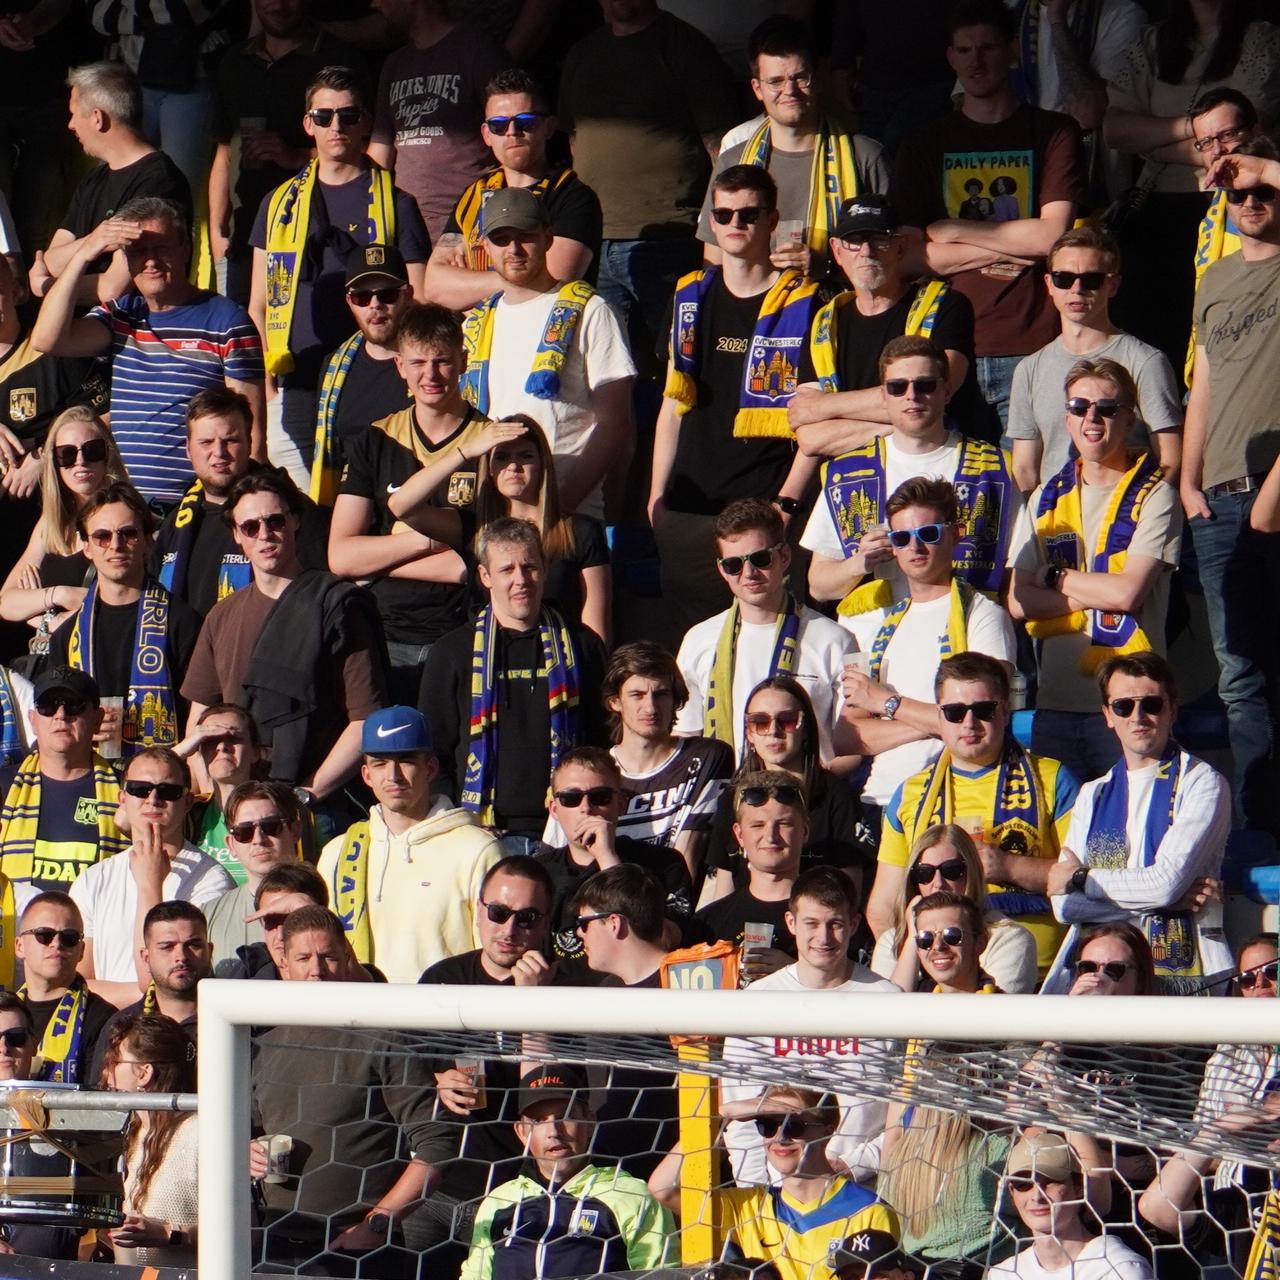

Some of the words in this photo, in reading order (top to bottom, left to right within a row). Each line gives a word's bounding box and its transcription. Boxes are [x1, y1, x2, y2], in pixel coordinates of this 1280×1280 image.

[945, 158, 986, 169] DAILY
[991, 157, 1031, 168] PAPER
[717, 336, 747, 353] 2024
[136, 586, 169, 674] ERLO
[341, 831, 366, 932] K.V.C.
[851, 1233, 871, 1252] NY
